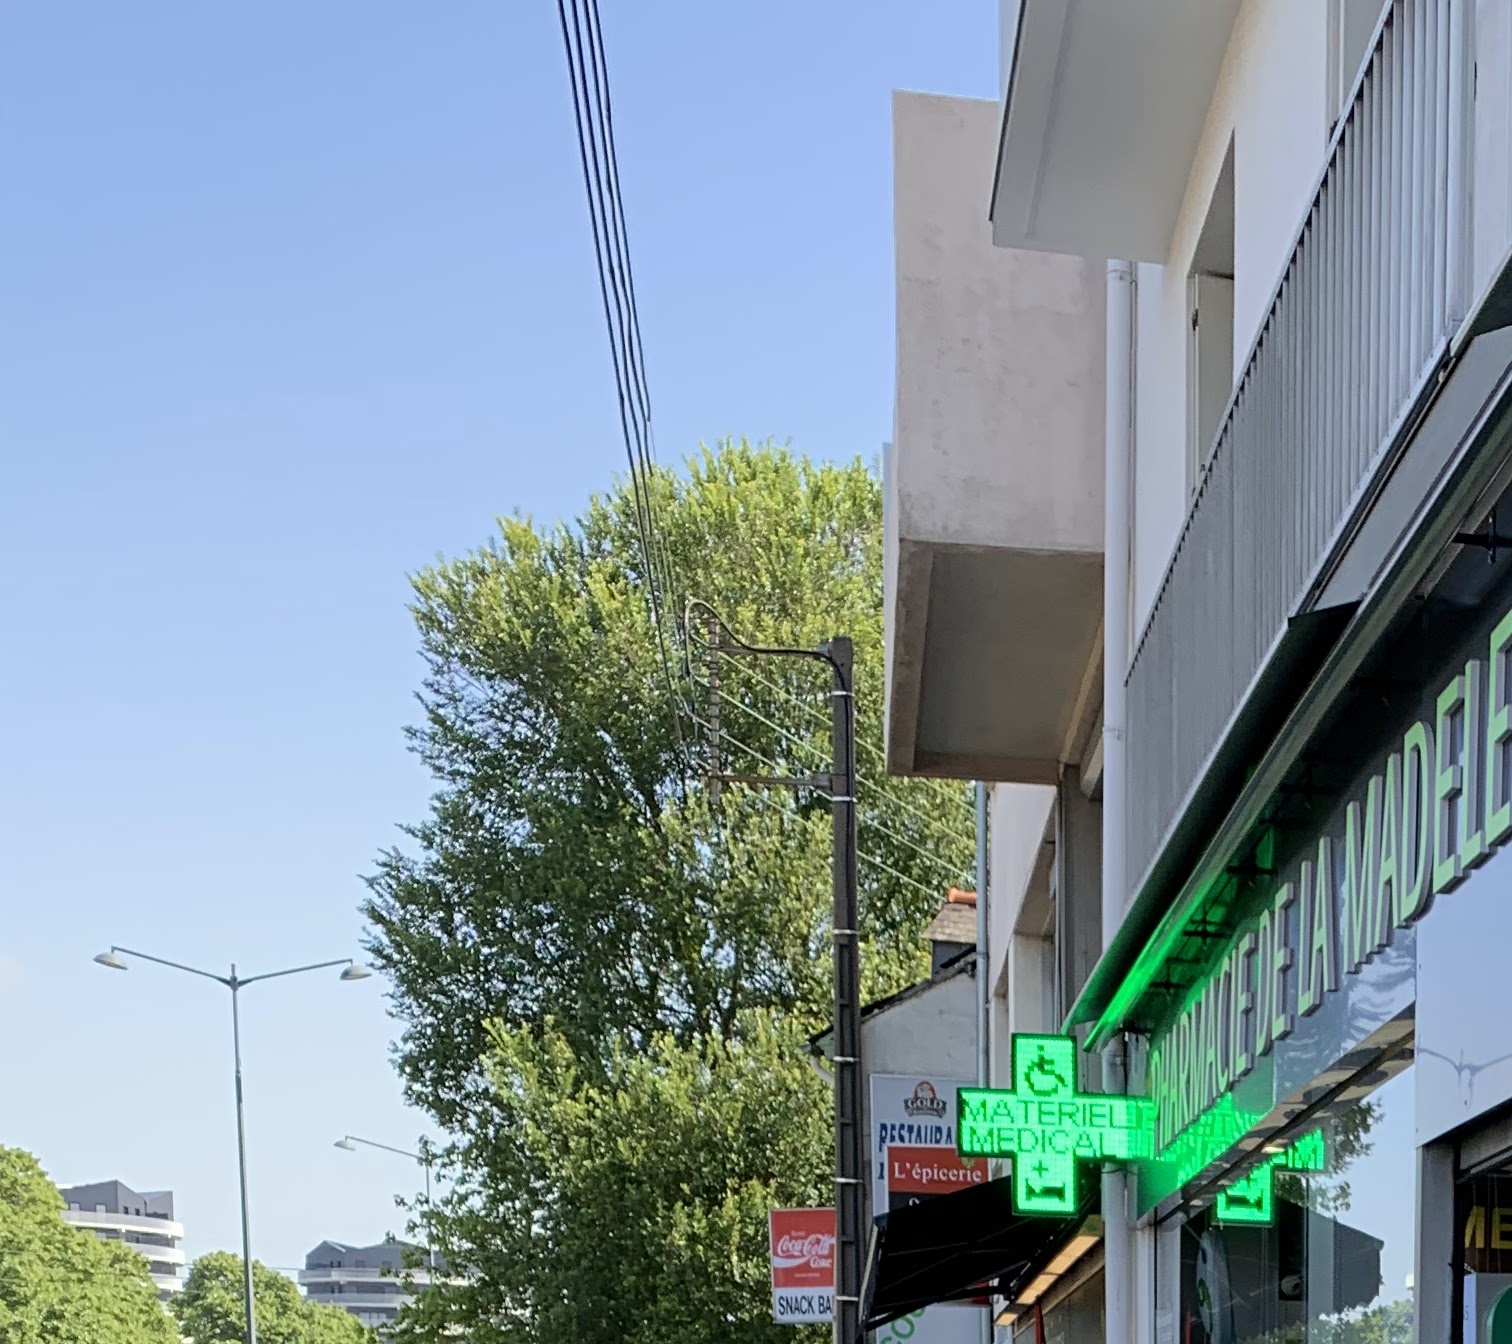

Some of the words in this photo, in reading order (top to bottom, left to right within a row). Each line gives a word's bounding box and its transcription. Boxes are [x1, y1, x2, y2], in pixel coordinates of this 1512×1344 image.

[1151, 930, 1256, 1157] PHARMACIE
[1255, 880, 1295, 1058] DE
[1297, 835, 1341, 1018] LA
[907, 1098, 943, 1109] GOLD
[962, 1099, 1128, 1129] MATERIEL
[969, 1126, 1117, 1157] MEDICAL
[893, 1161, 982, 1184] L'épicerie
[778, 1295, 815, 1316] SNACK
[818, 1295, 832, 1315] BA
